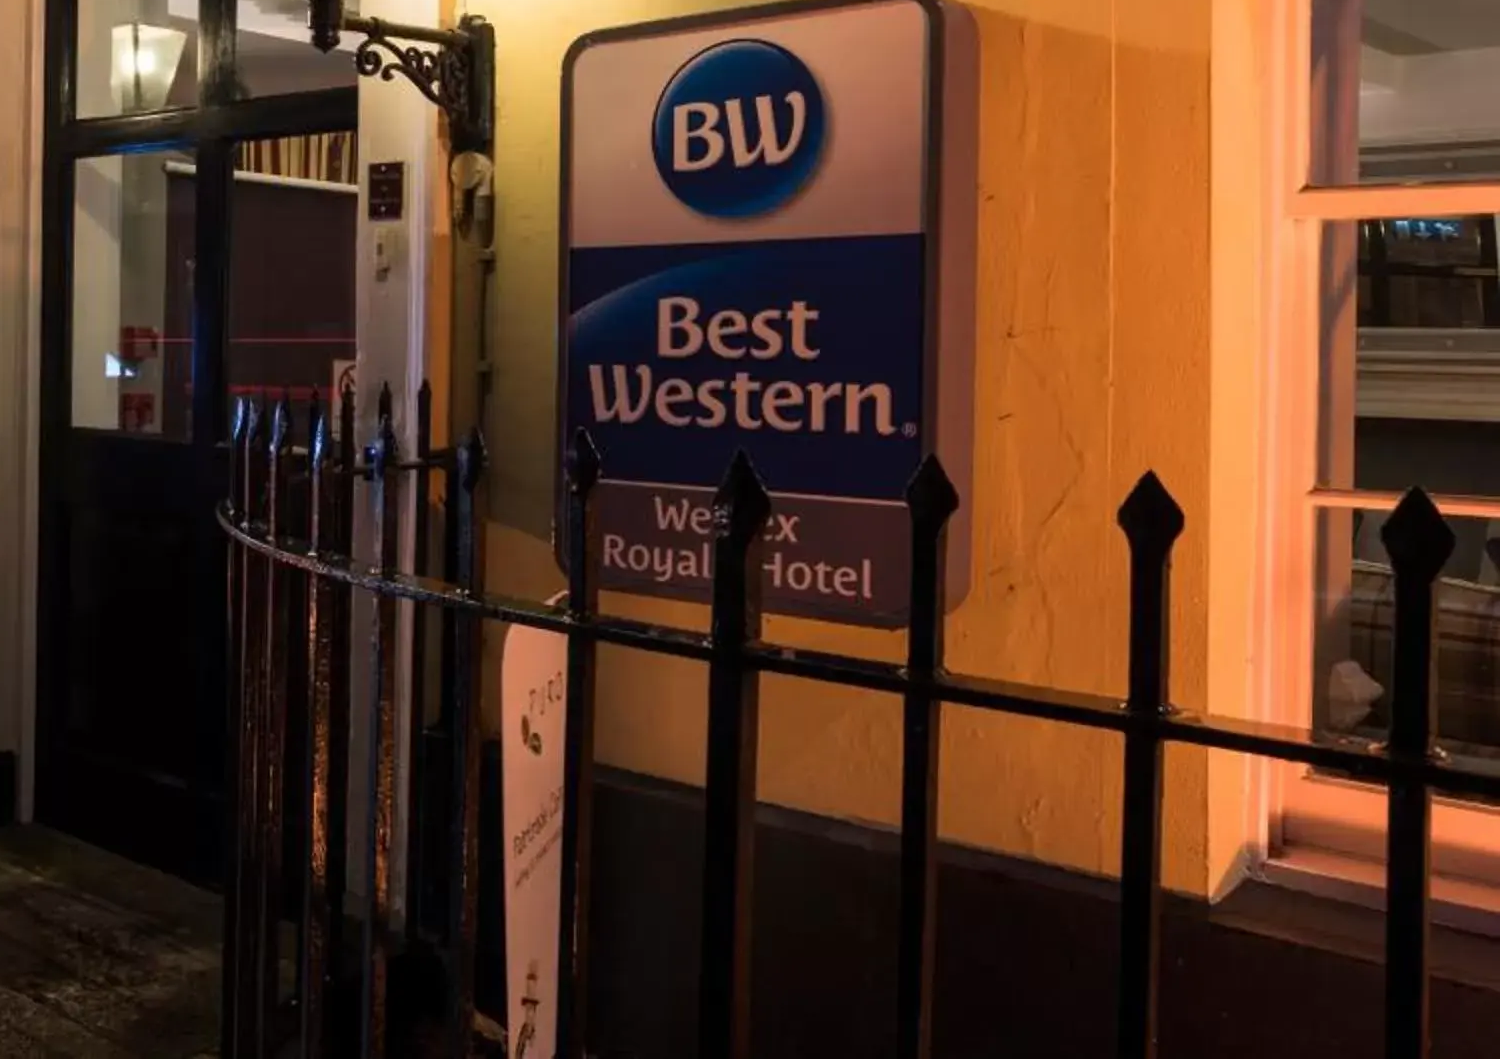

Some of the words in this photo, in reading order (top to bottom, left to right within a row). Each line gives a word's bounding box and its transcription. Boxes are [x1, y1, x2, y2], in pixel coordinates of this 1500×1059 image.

[673, 91, 806, 172] BW
[657, 296, 820, 360] Best
[654, 495, 799, 542] Wex
[603, 534, 712, 582] Royal
